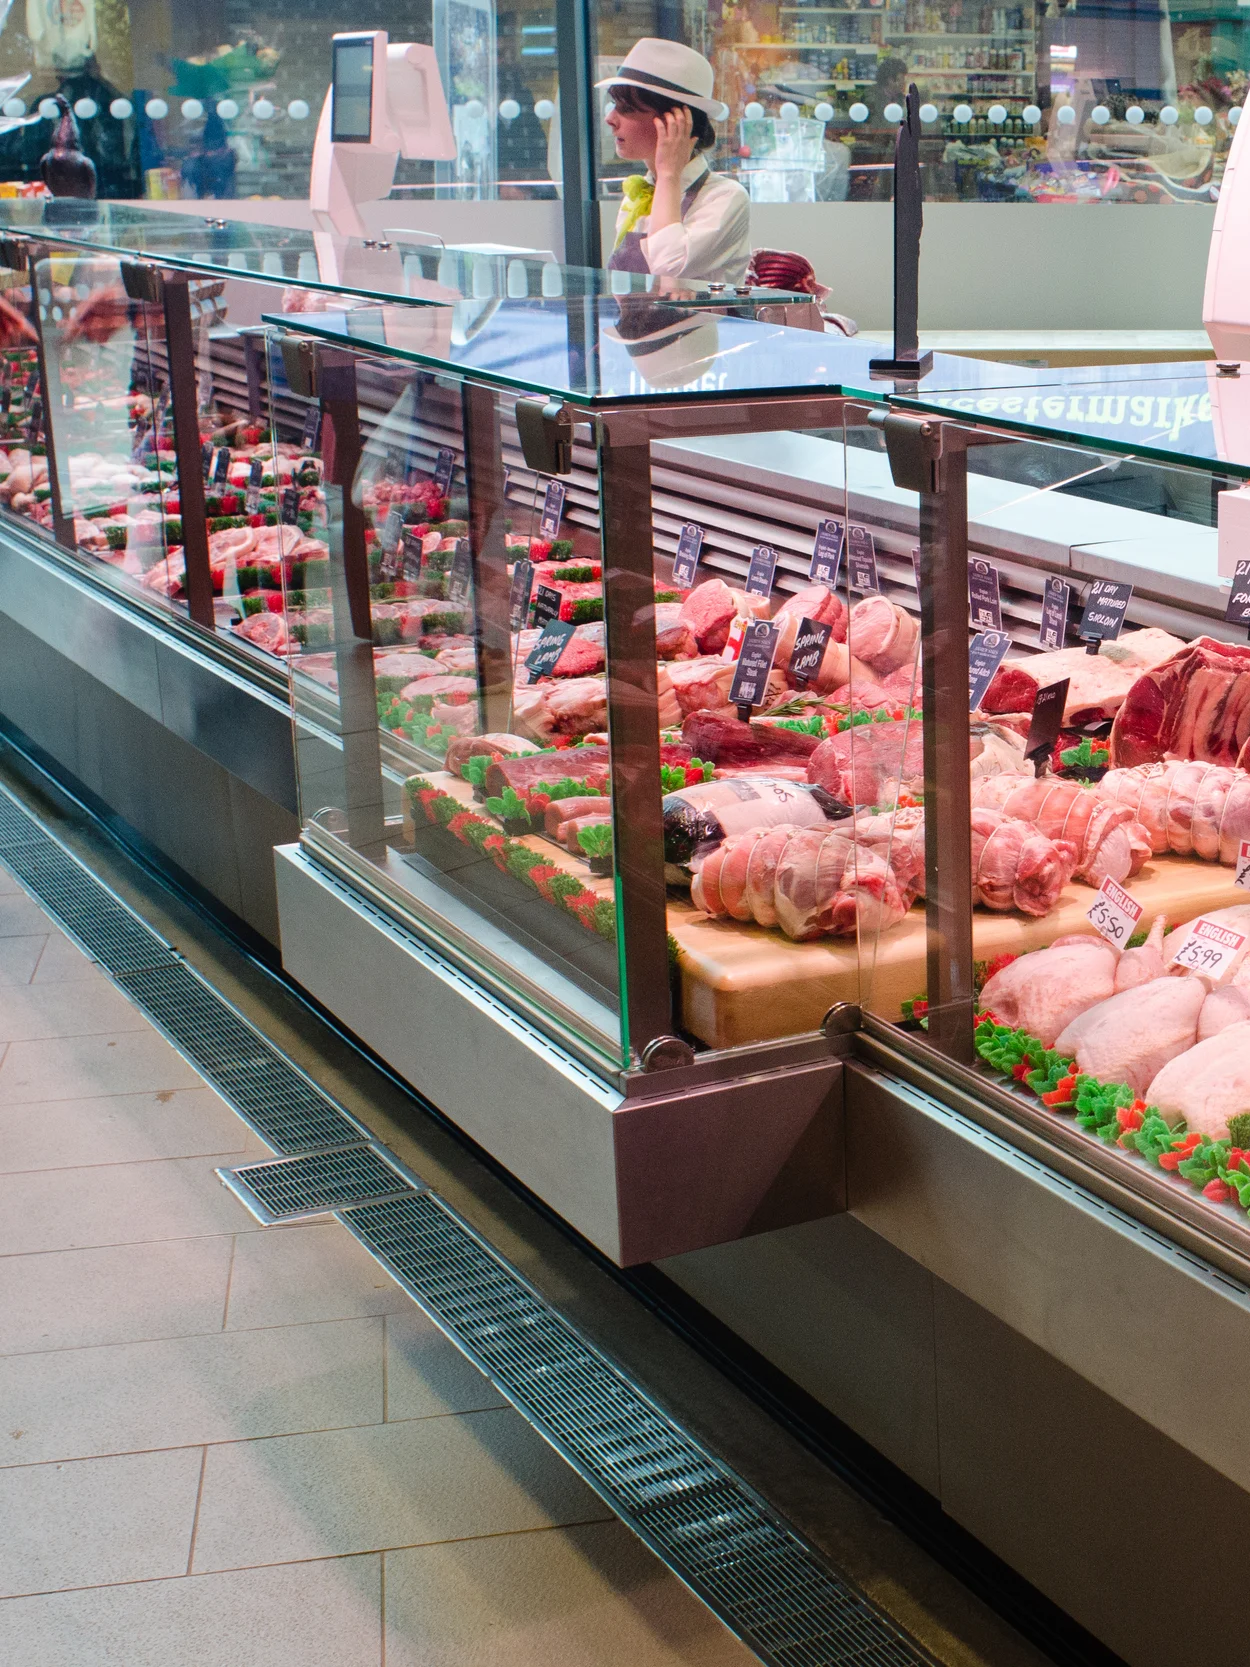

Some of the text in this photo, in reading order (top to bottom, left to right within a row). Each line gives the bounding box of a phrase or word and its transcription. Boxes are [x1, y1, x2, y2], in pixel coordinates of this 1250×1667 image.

[1236, 561, 1250, 575] 21
[1091, 581, 1118, 595] 21 DAY
[1097, 597, 1127, 609] MATURED
[1088, 612, 1118, 627] SIRLOIN
[533, 633, 566, 651] SPRING
[794, 630, 825, 651] SPRING
[534, 647, 562, 665] LAMB
[795, 650, 820, 670] LAMB
[1106, 883, 1137, 917] ENGLISH
[1087, 901, 1124, 939] £5.50
[1198, 923, 1241, 949] ENGLISH
[1172, 935, 1223, 969] £5.99
